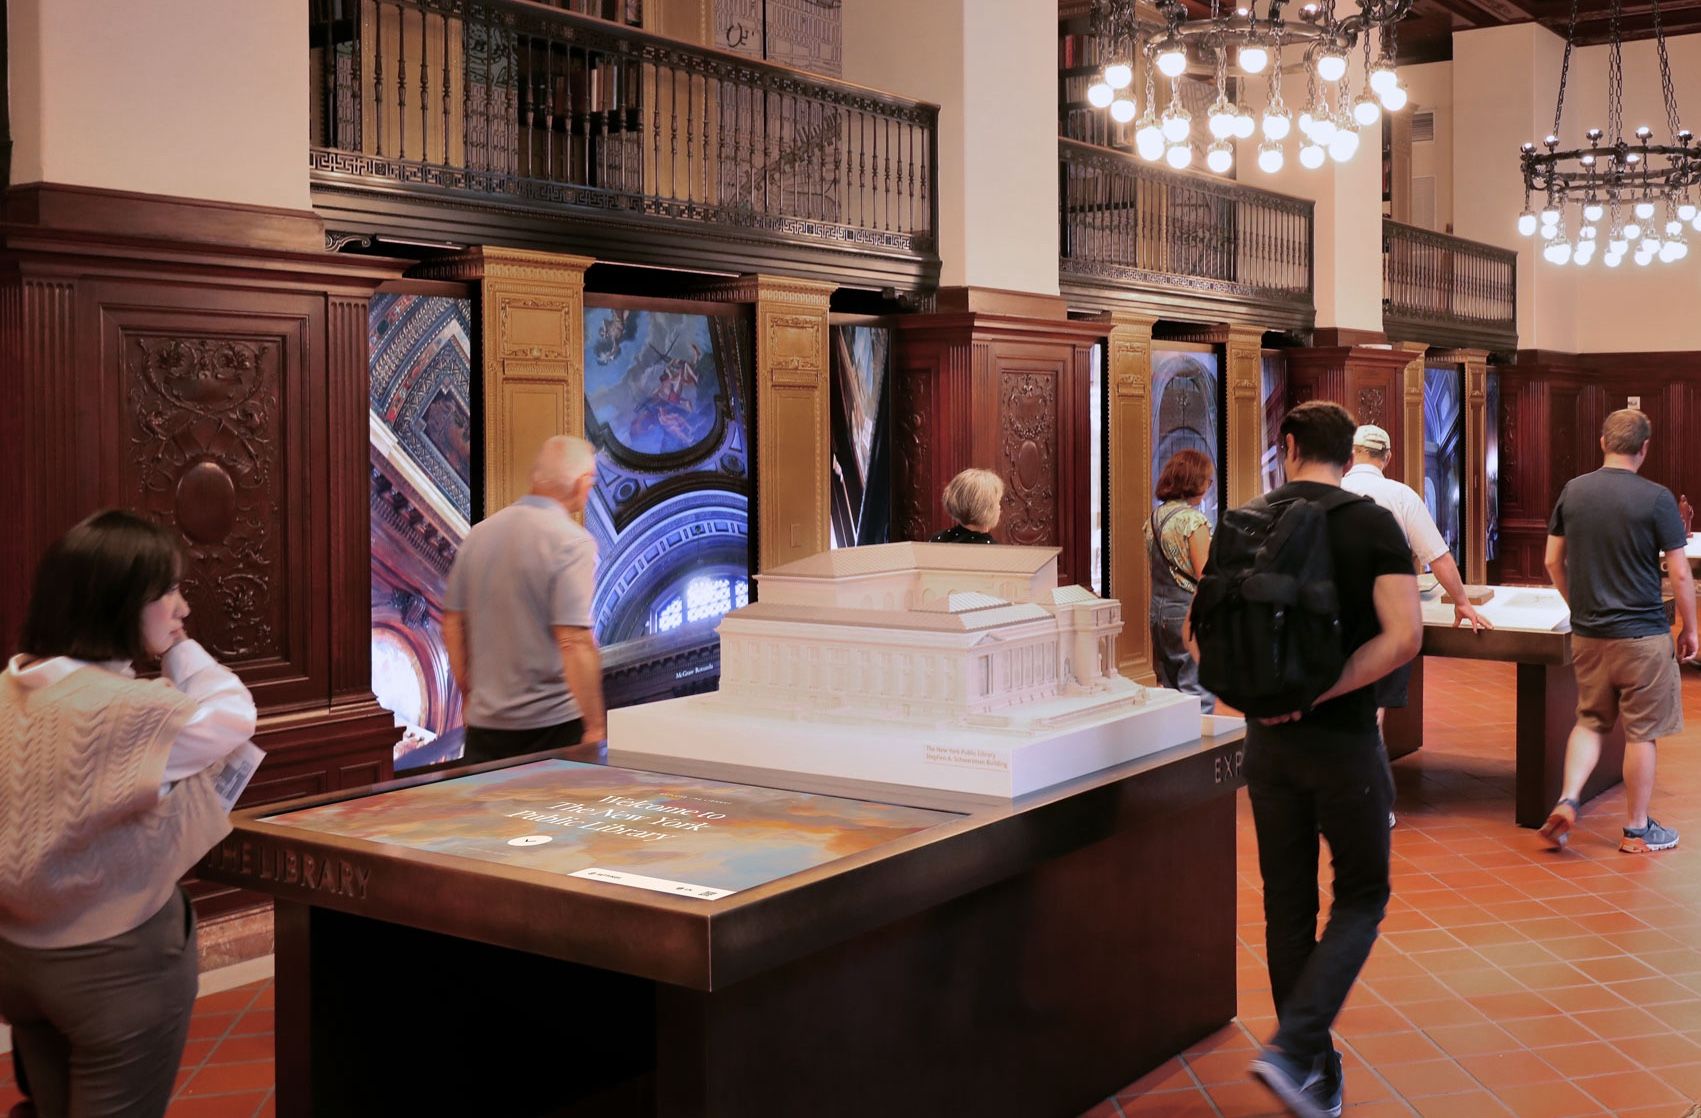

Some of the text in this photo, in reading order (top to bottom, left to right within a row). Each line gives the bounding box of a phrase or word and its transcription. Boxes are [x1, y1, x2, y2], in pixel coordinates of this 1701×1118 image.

[546, 801, 712, 831] The New York
[599, 795, 699, 816] Welcome
[697, 811, 727, 820] to
[505, 810, 681, 842] Public Library
[259, 846, 372, 900] LIBRARY
